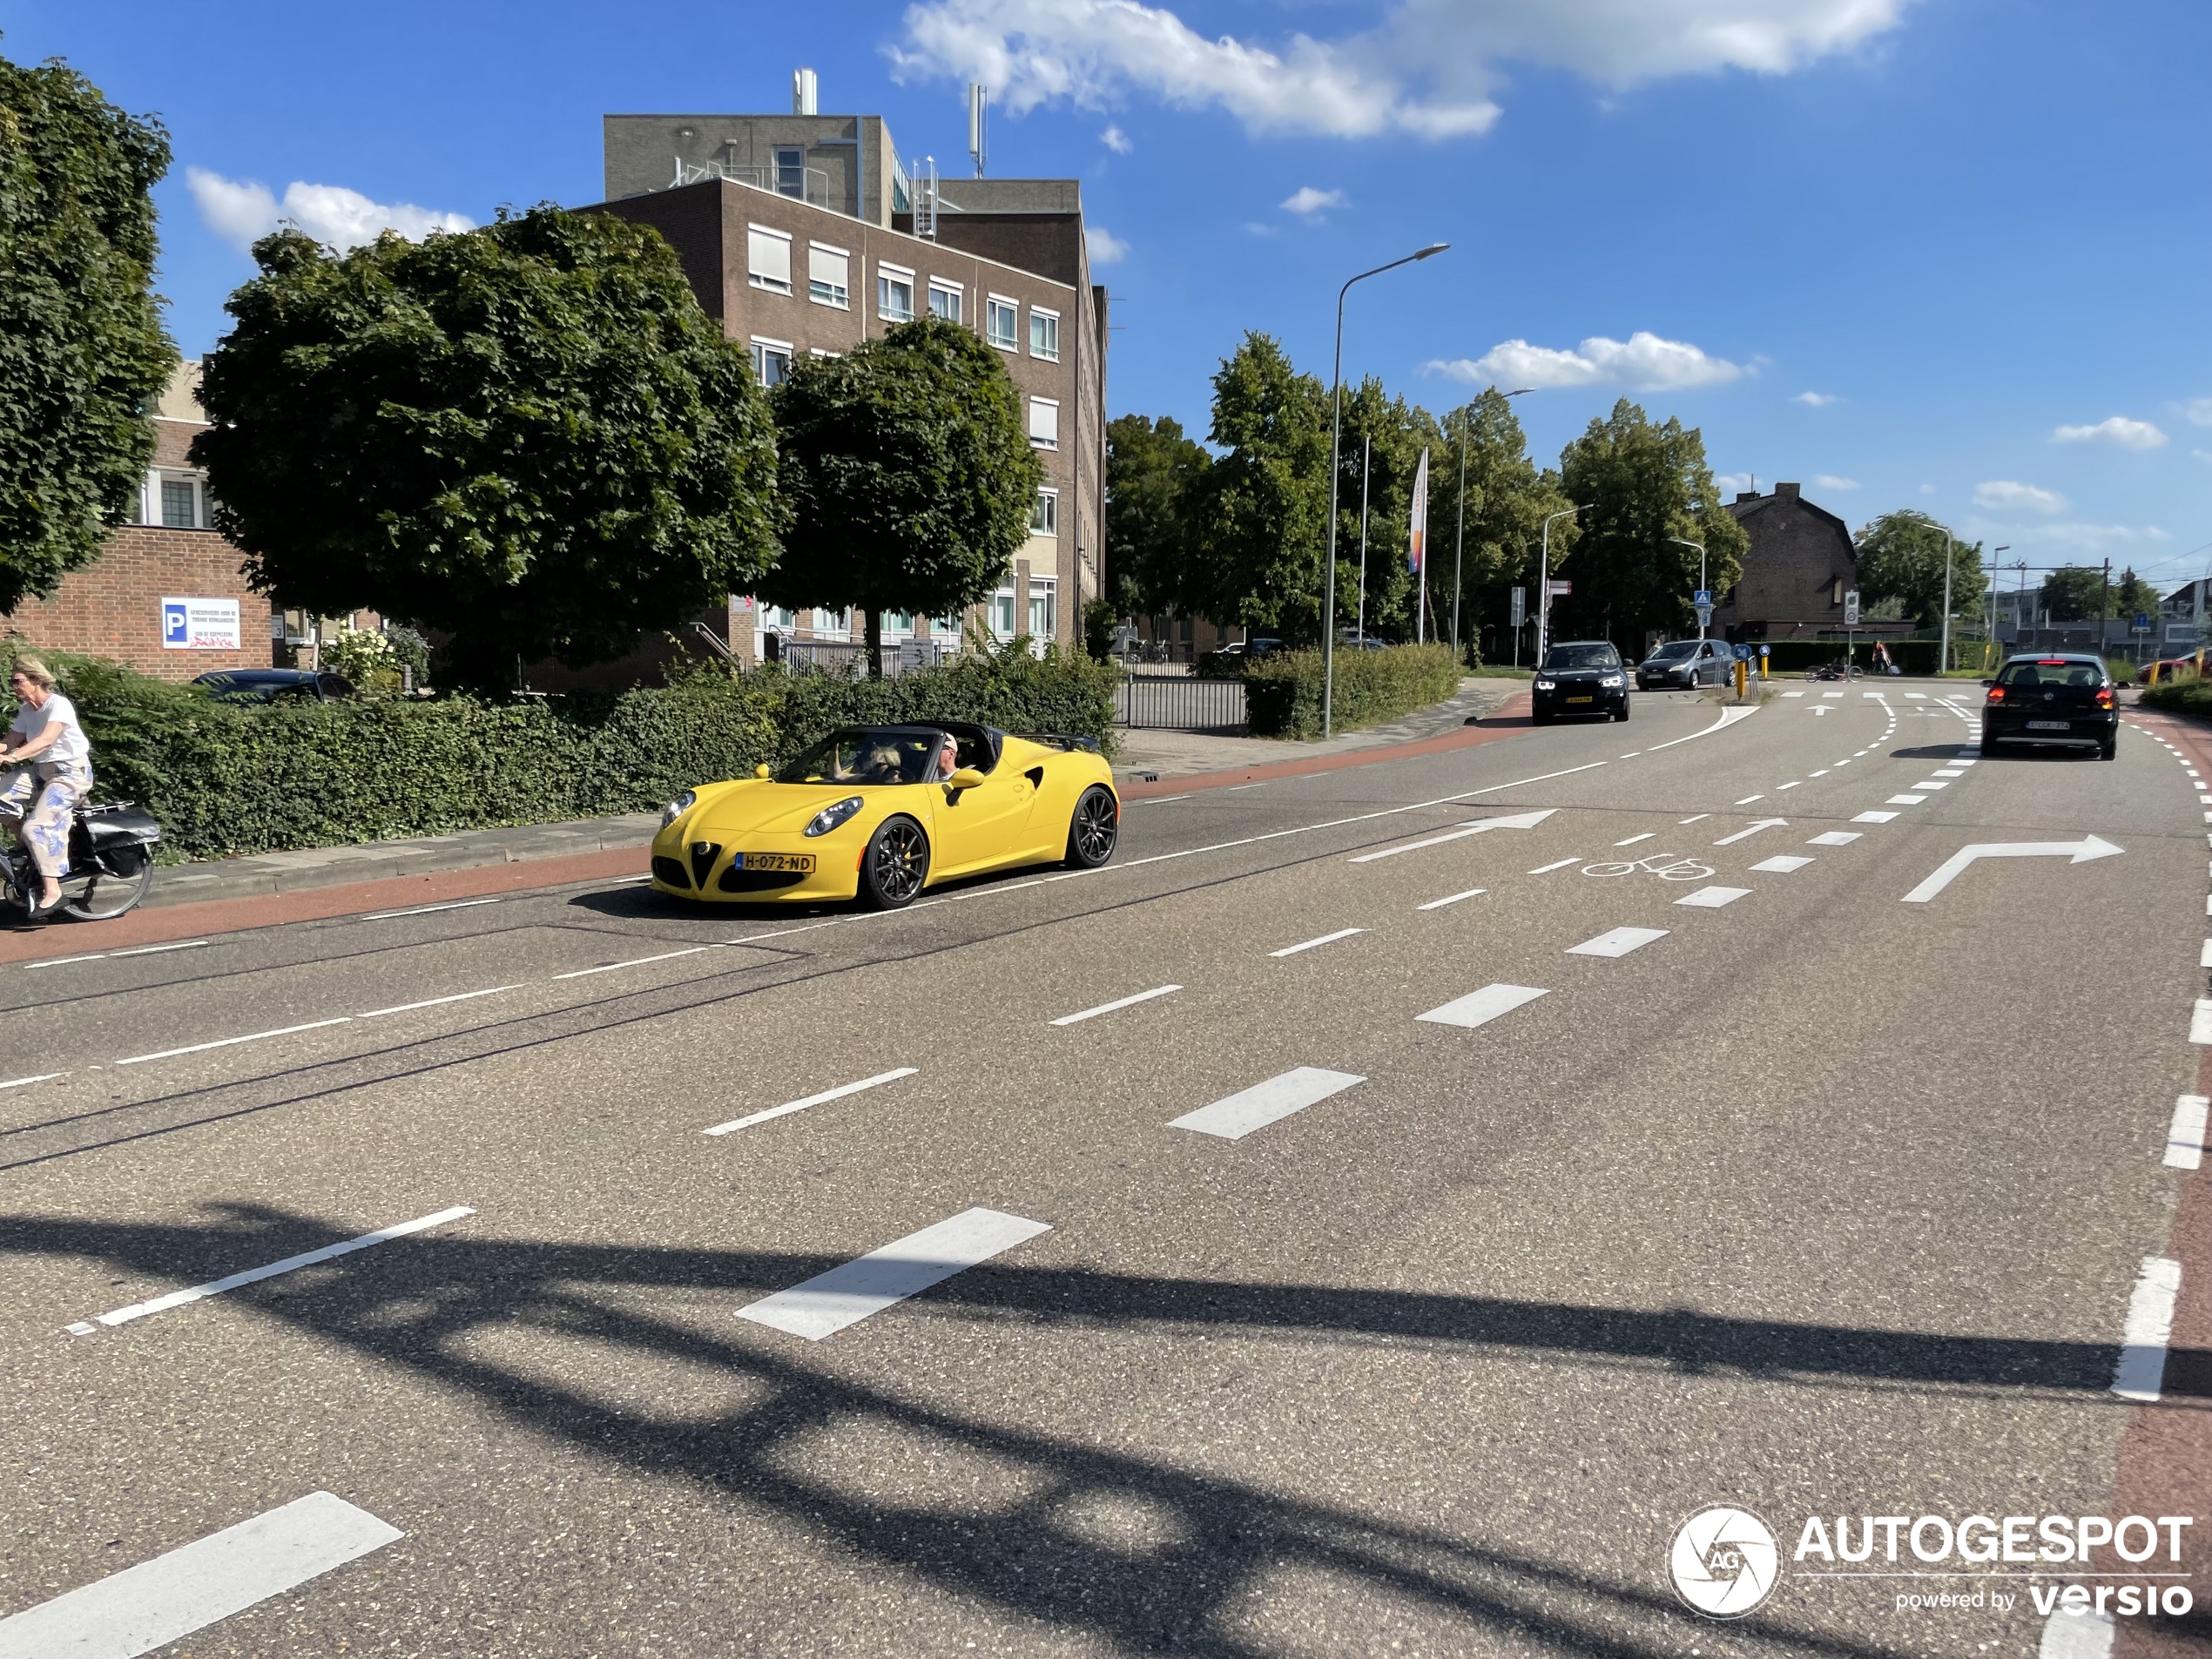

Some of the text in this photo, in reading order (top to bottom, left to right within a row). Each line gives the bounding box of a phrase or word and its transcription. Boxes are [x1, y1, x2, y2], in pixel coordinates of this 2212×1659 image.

[745, 597, 752, 608] 5
[166, 612, 185, 636] P
[276, 628, 282, 637] 3
[745, 855, 810, 870] H-072-ND
